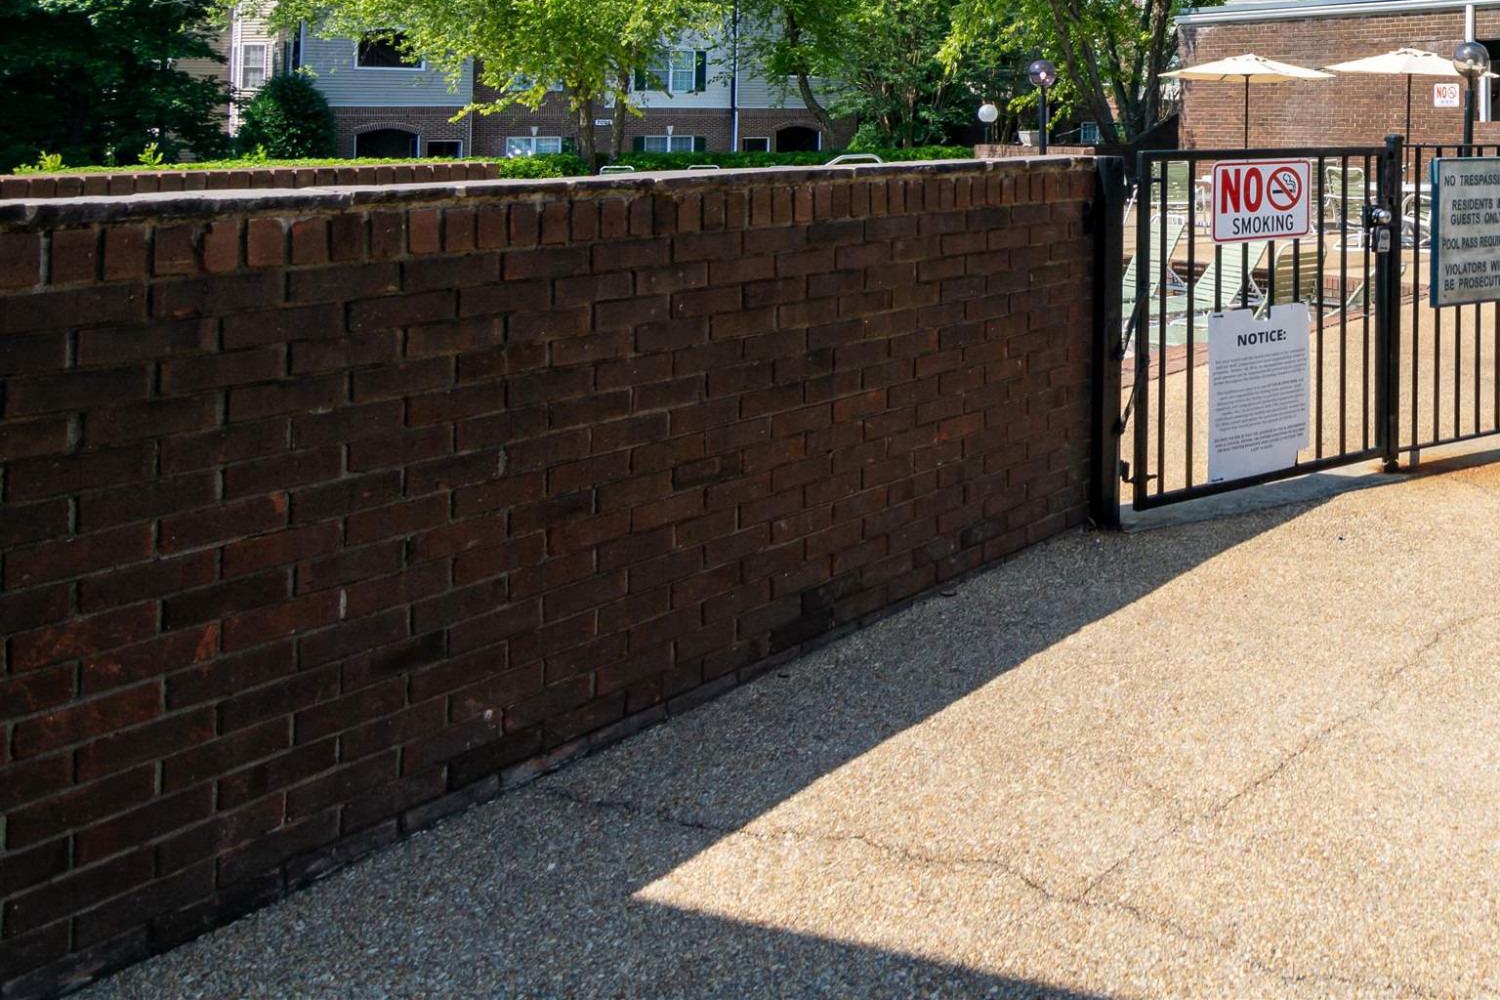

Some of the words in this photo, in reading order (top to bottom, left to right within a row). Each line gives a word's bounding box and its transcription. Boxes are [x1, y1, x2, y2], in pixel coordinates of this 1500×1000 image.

[1444, 175, 1456, 187] NO
[1221, 167, 1263, 214] NO
[1452, 199, 1493, 211] RESIDENTS
[1232, 214, 1294, 235] SMOKING
[1451, 212, 1481, 225] GUESTS
[1442, 237, 1460, 250] POOL
[1461, 236, 1478, 248] PASS
[1445, 261, 1487, 276] VIOLATORS
[1444, 279, 1455, 291] BE
[1237, 329, 1287, 347] NOTICE:
